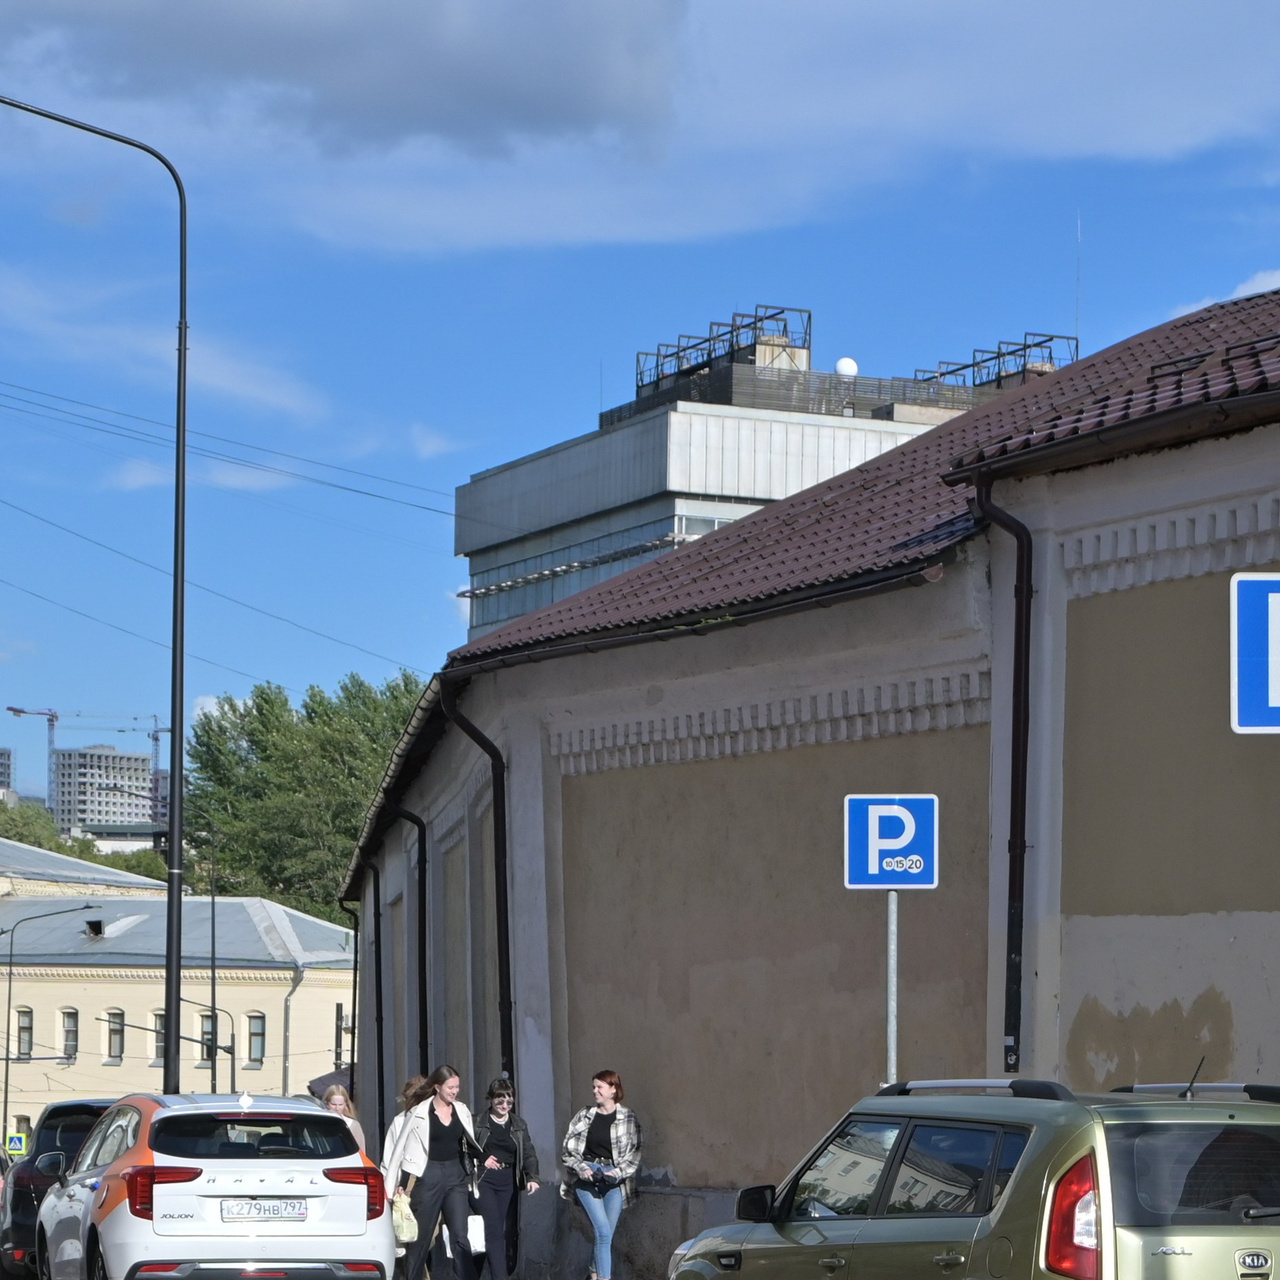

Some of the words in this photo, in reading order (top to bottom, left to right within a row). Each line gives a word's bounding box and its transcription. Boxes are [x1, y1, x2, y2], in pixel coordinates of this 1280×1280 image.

[867, 804, 916, 875] P
[885, 860, 893, 868] 10
[895, 859, 905, 868] 15
[907, 858, 922, 870] 20
[282, 1201, 303, 1212] 797
[1244, 1256, 1266, 1267] KIA
